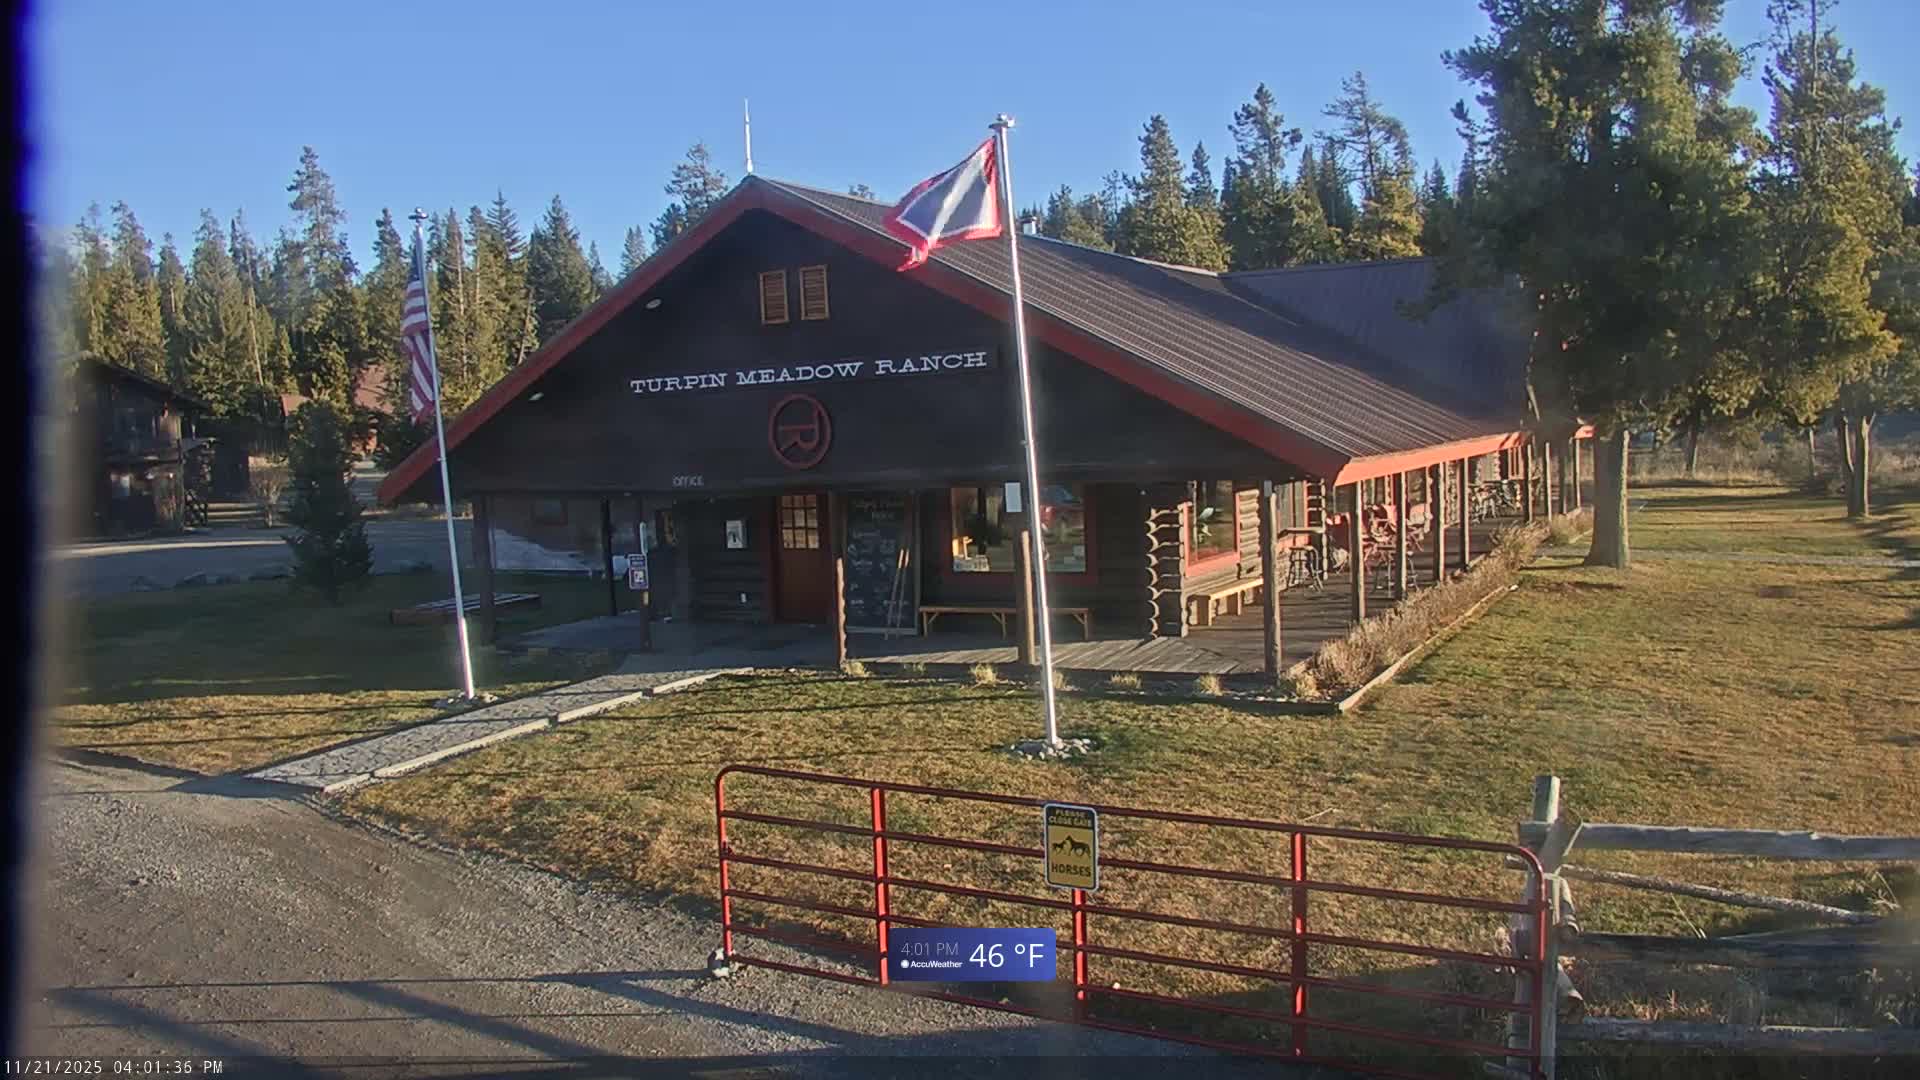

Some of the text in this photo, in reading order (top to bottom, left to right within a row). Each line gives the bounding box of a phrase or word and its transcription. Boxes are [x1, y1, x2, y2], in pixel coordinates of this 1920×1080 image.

[630, 352, 987, 393] TURPIN MEADOW RANCH
[673, 475, 704, 488] OFFICE
[1055, 809, 1087, 818] PLEASE
[1048, 816, 1072, 826] CLOSE
[1051, 863, 1091, 877] HORSES
